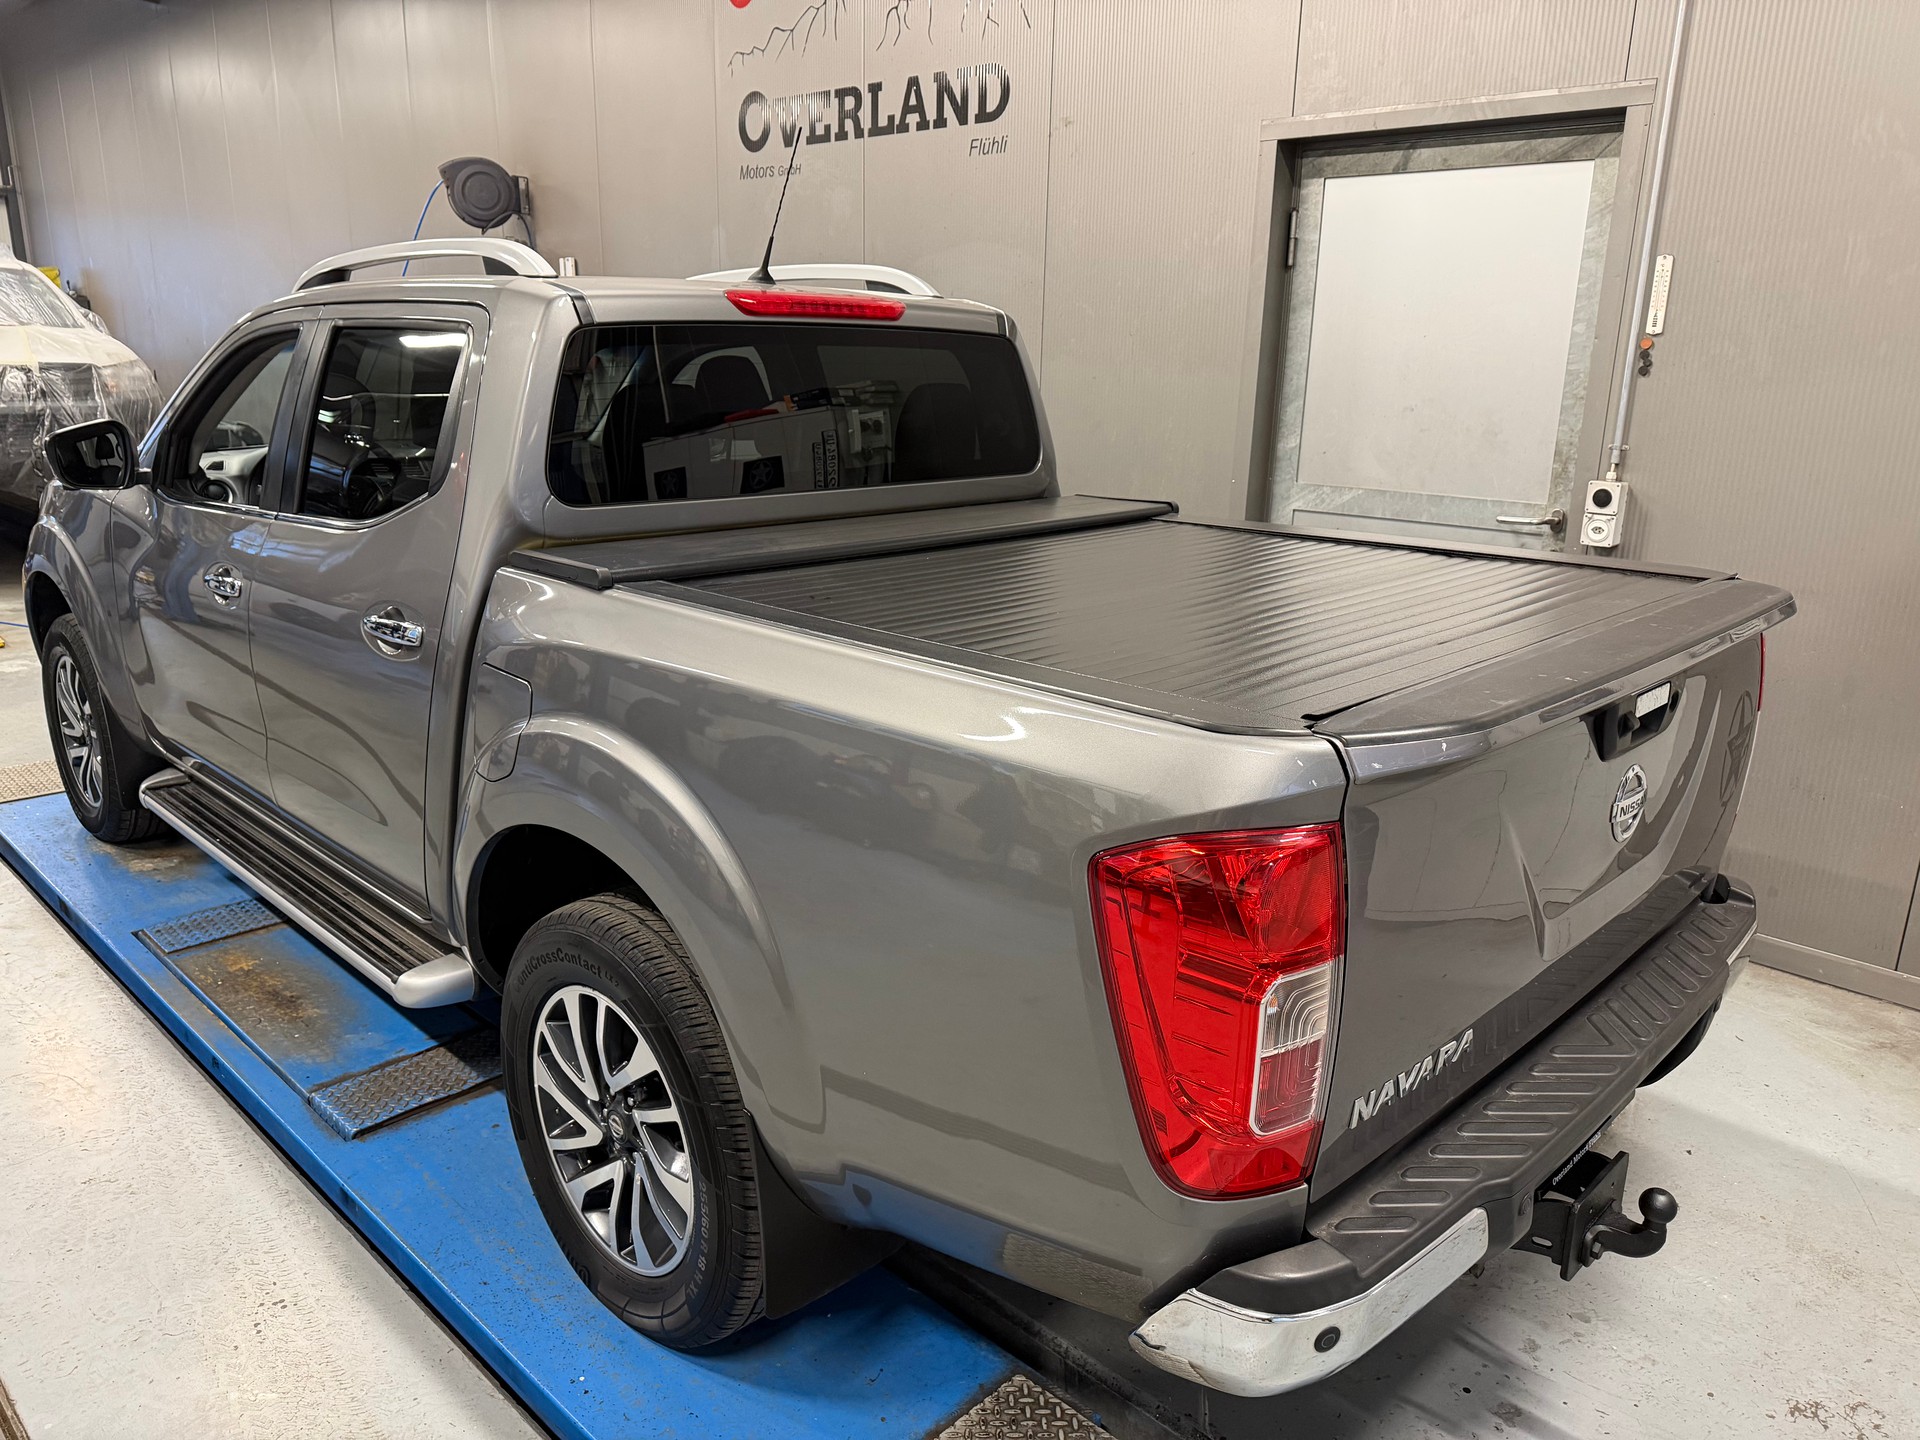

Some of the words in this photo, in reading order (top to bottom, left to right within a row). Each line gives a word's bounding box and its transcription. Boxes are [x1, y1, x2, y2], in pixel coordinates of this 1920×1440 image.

[738, 62, 1011, 153] OVERLAND
[968, 135, 1009, 157] Flühli
[739, 164, 775, 180] Motors
[1619, 795, 1646, 818] NISSA
[1348, 1028, 1474, 1130] NAVARA
